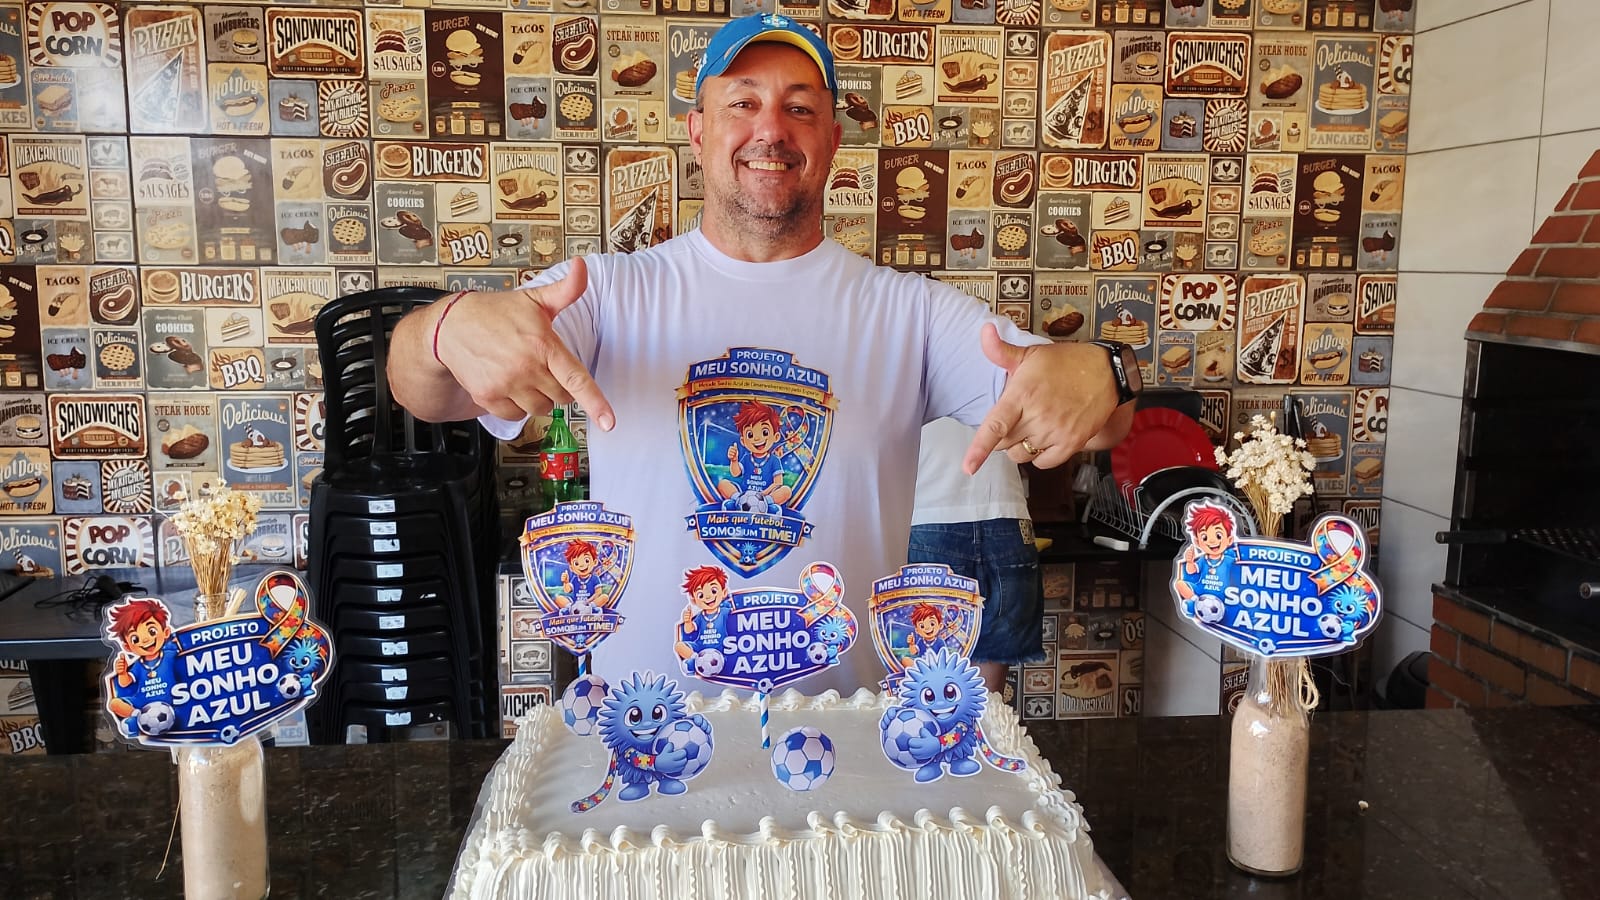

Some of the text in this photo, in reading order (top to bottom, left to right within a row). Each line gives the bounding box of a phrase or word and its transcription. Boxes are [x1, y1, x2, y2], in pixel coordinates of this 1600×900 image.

[51, 10, 96, 33] POP
[902, 9, 945, 18] HOT FRESH
[213, 17, 260, 41] HAMBURGERS
[431, 16, 471, 32] BURGER
[510, 24, 545, 34] TACOS
[555, 20, 589, 43] STEAK
[132, 17, 195, 57] PIZZA
[275, 17, 357, 57] SANDWICHES
[606, 30, 660, 42] STEAK HOUSE
[862, 28, 929, 60] BURGERS
[45, 35, 103, 57] CORN
[941, 36, 999, 59] MEXICAN FOOD
[1120, 41, 1161, 65] HAMBURGERS
[1258, 44, 1308, 57] STEAK HOUSE
[373, 54, 423, 71] SAUSAGES
[1050, 40, 1105, 77] PIZZA
[1174, 40, 1246, 76] SANDWICHES
[1316, 42, 1374, 71] Delicious
[380, 82, 416, 99] Pizza
[556, 81, 596, 97] Delicious
[836, 79, 872, 90] COOKIES
[333, 92, 361, 108] KITCHEN
[893, 112, 931, 146] BBQ
[1113, 137, 1155, 146] HOT FRESH
[1310, 133, 1370, 146] PANCAKES
[16, 145, 81, 169] MEXICAN FOOD
[280, 150, 314, 160] TACOS
[325, 145, 361, 168] STEAK
[411, 145, 483, 178] BURGERS
[496, 153, 557, 176] MEXICAN FOOD
[884, 154, 920, 170] BURGER
[955, 160, 987, 170] TACOS
[996, 154, 1030, 177] STEAK
[1073, 157, 1137, 188] BURGERS
[1303, 159, 1338, 174] BURGER
[1371, 165, 1402, 175] TACOS
[612, 155, 671, 196] PIZZA
[1149, 164, 1204, 186] MEXICAN FOOD
[139, 182, 190, 199] SAUSAGES
[828, 190, 874, 207] SAUSAGES
[386, 197, 425, 209] COOKIES
[1047, 206, 1082, 216] COOKIES
[1249, 194, 1292, 211] SAUSAGES
[328, 206, 369, 222] Delicious
[994, 213, 1031, 228] Delicious
[833, 216, 867, 233] Pizza
[1253, 219, 1284, 235] Pizza
[449, 230, 491, 264] BBQ
[1101, 237, 1138, 269] BBQ
[44, 276, 81, 287] TACOS
[91, 270, 129, 294] STEAK
[180, 271, 254, 303] BURGERS
[268, 276, 331, 301] MEXICAN FOOD
[973, 280, 992, 302] FOOD
[1039, 285, 1088, 296] STEAK HOUSE
[1182, 281, 1218, 300] POP
[1098, 281, 1154, 309] Delicious
[1245, 282, 1299, 321] PIZZA
[1313, 283, 1353, 304] HAMBURGERS
[1173, 302, 1222, 321] CORN
[155, 322, 195, 333] COOKIES
[95, 331, 137, 348] Delicious
[736, 351, 785, 363] PROJETO
[220, 355, 265, 389] BBQ
[694, 361, 825, 388] MEU SONHO AZUL
[1304, 373, 1344, 382] HOT FRESH
[154, 405, 211, 416] STEAK HOUSE
[1237, 400, 1284, 410] STEAK HOUSE
[58, 403, 140, 438] SANDWICHES
[222, 401, 288, 430] Delicious
[0, 501, 47, 511] HOT FRESH
[561, 504, 598, 513] PROJETO
[530, 516, 555, 529] MEU
[557, 512, 597, 524] SONHO
[707, 514, 729, 524] Mais
[731, 516, 748, 525] que
[88, 525, 130, 544] POP
[701, 526, 797, 543] SOMOS UM TIME!
[82, 547, 137, 566] CORN
[1249, 548, 1312, 567] PROJETO
[907, 567, 943, 575] PROJETO
[1240, 566, 1301, 592] MEU
[878, 580, 901, 592] MEU
[903, 575, 942, 586] SONHO
[743, 593, 799, 606] PROJETO
[1224, 587, 1323, 617] SONHO
[587, 621, 614, 631] TIME!
[737, 610, 791, 633] MEU
[1232, 609, 1310, 638] AZUL
[190, 621, 260, 645] PROJETO
[723, 630, 811, 656] SONHO
[185, 642, 253, 677] MEU
[732, 652, 801, 675] AZUL
[140, 681, 168, 693] SONHO
[144, 677, 162, 686] MEU
[170, 663, 280, 706] SONHO
[145, 688, 166, 698] AZUL
[187, 690, 271, 728] AZUL
